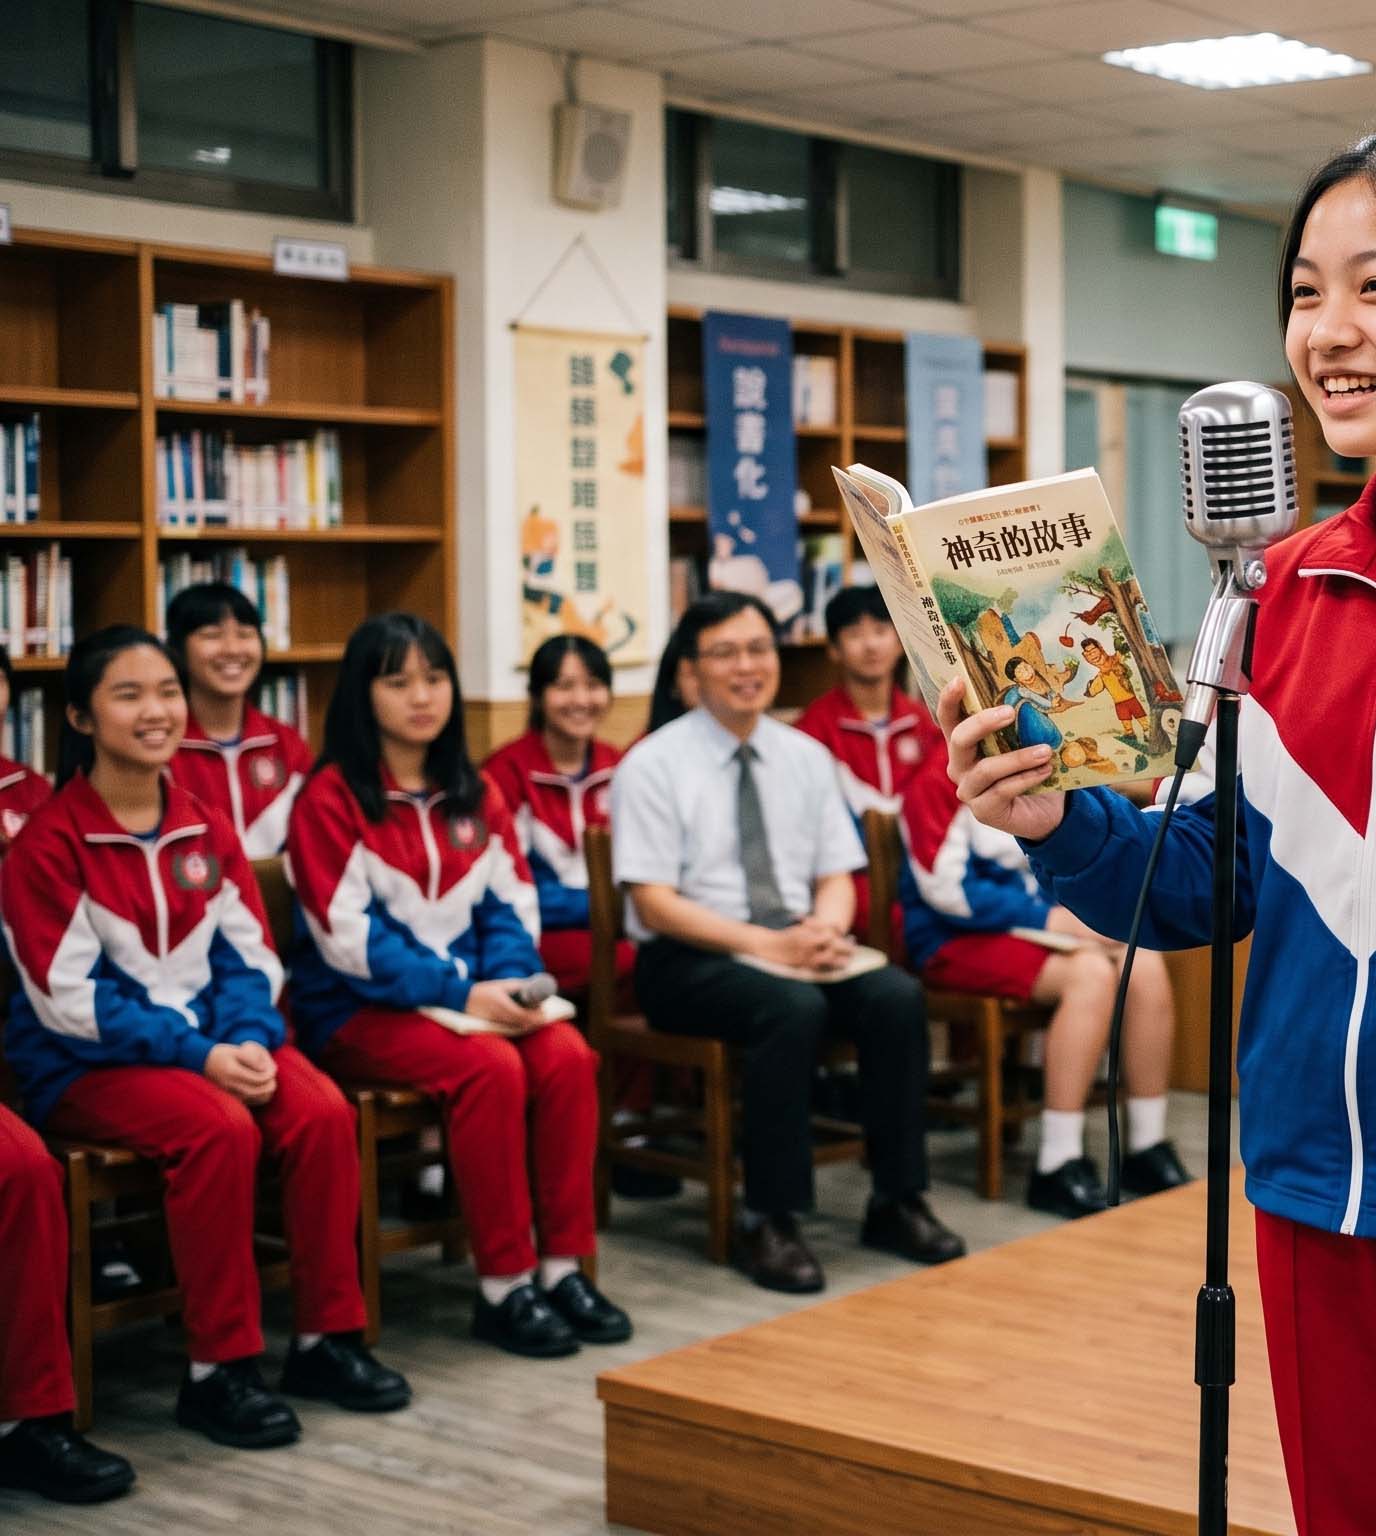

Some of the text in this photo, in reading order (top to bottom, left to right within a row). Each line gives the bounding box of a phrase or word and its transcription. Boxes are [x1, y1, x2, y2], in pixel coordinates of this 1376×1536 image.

[941, 512, 1093, 571] 神奇的故事
